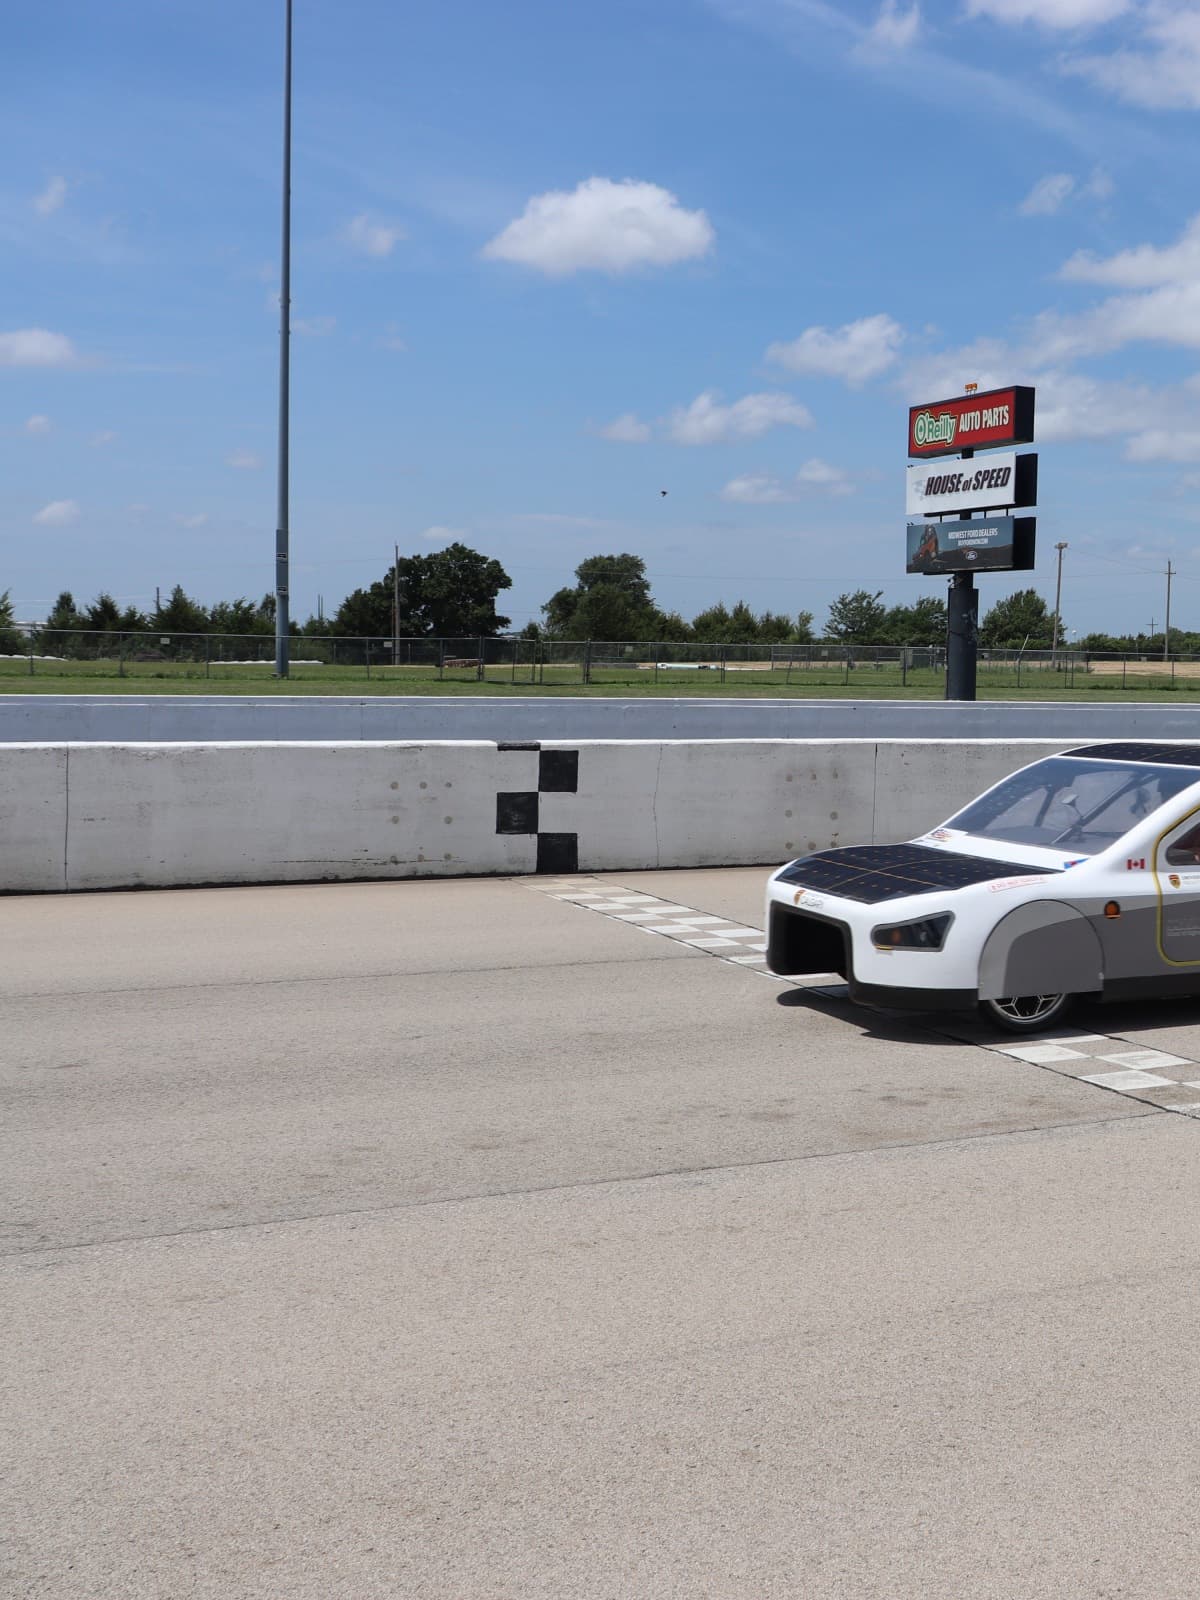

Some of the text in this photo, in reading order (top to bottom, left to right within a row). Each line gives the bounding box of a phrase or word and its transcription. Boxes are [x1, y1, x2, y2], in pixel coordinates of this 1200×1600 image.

[914, 405, 1009, 445] O'Reilly AUTO PARTS
[925, 466, 1011, 496] HOUSE of SPEED
